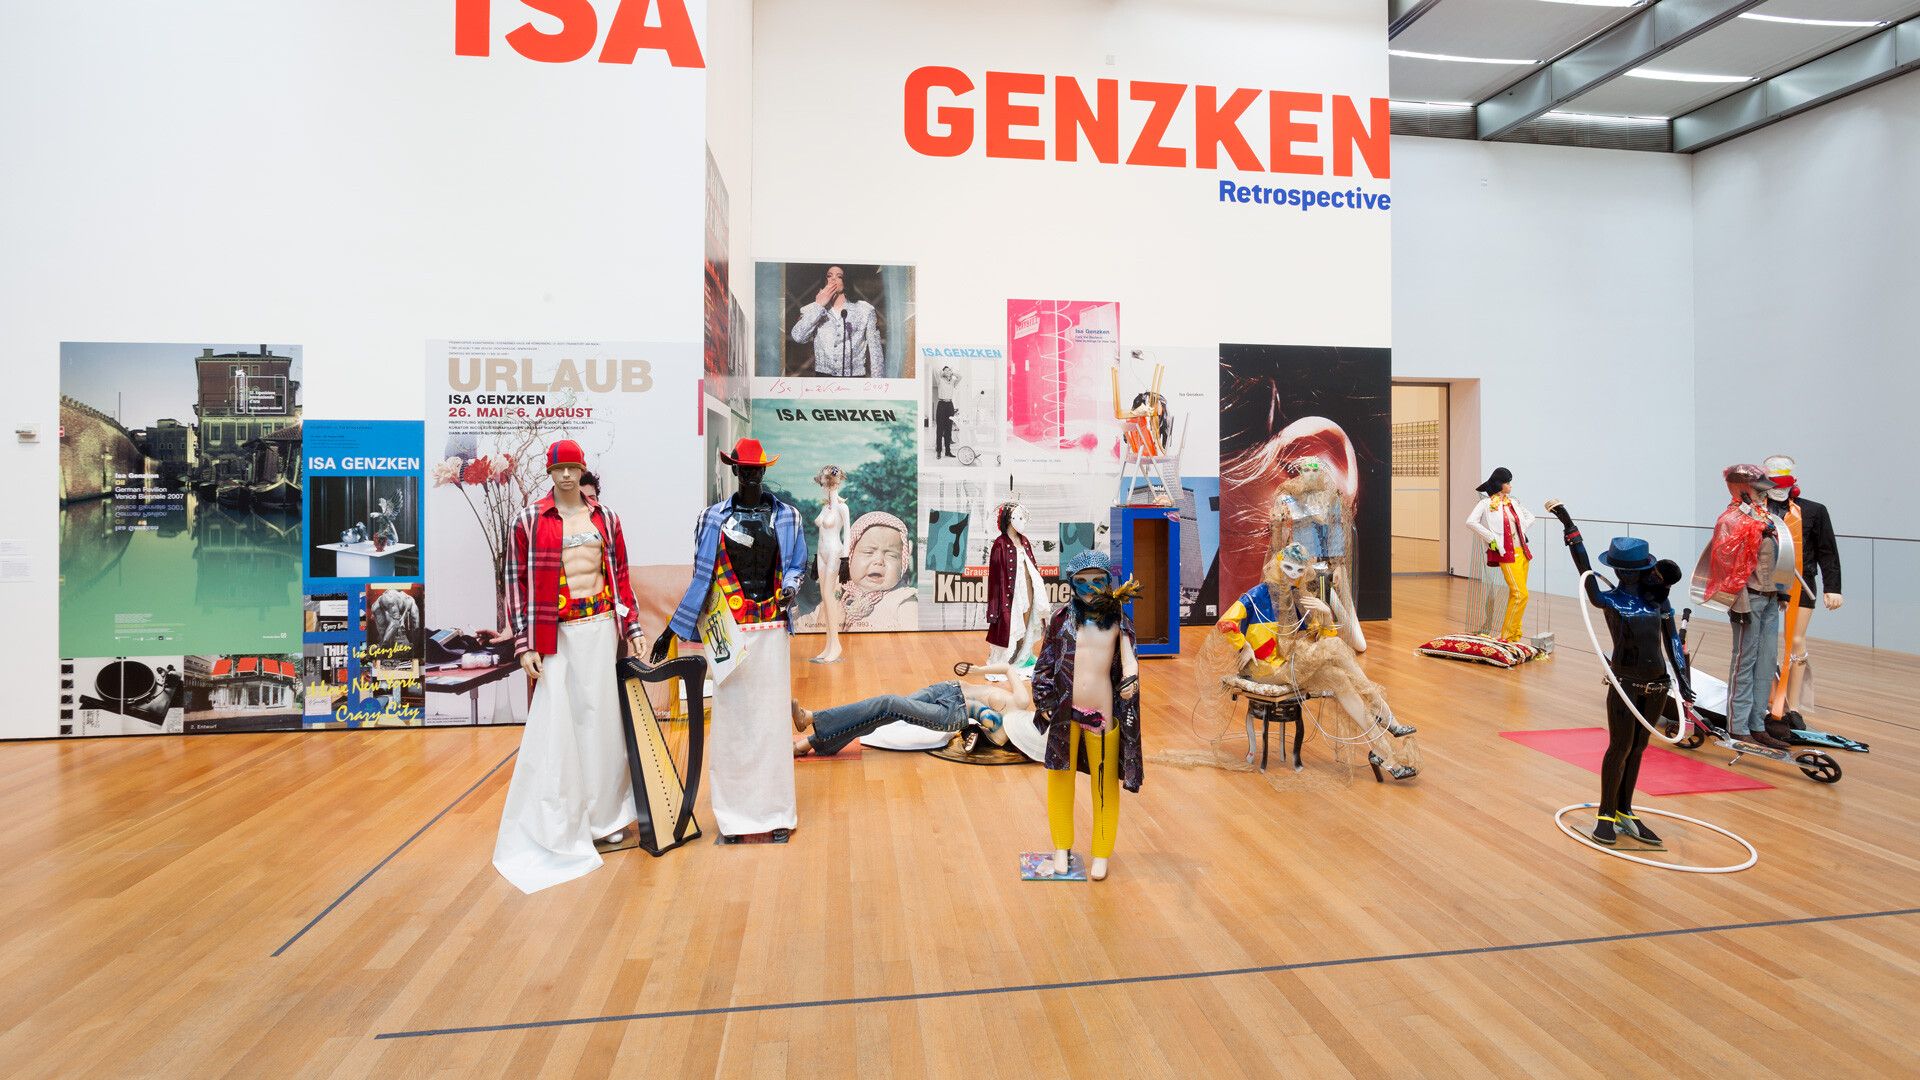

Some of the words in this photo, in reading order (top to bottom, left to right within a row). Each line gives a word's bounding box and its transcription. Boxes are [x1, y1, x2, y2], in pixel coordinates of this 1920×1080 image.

[455, 0, 706, 68] ISA
[904, 66, 1390, 179] GENZKEN
[1219, 180, 1391, 211] Retrospective
[922, 348, 943, 357] ISA
[944, 348, 1002, 358] GENZKEN
[448, 358, 653, 392] URLAUB
[448, 394, 471, 404] ISA
[476, 394, 545, 405] GENZKEN
[448, 407, 470, 417] 26.
[476, 408, 503, 417] MAI
[517, 407, 530, 418] 6.
[536, 408, 593, 418] AUGUST
[776, 409, 808, 421] ISA
[812, 409, 896, 422] GENZKEN
[308, 457, 336, 470] ISA
[341, 457, 420, 470] GENZKEN
[964, 568, 989, 576] Graus
[352, 678, 380, 694] New
[336, 705, 382, 726] Crazy
[386, 701, 420, 720] City
